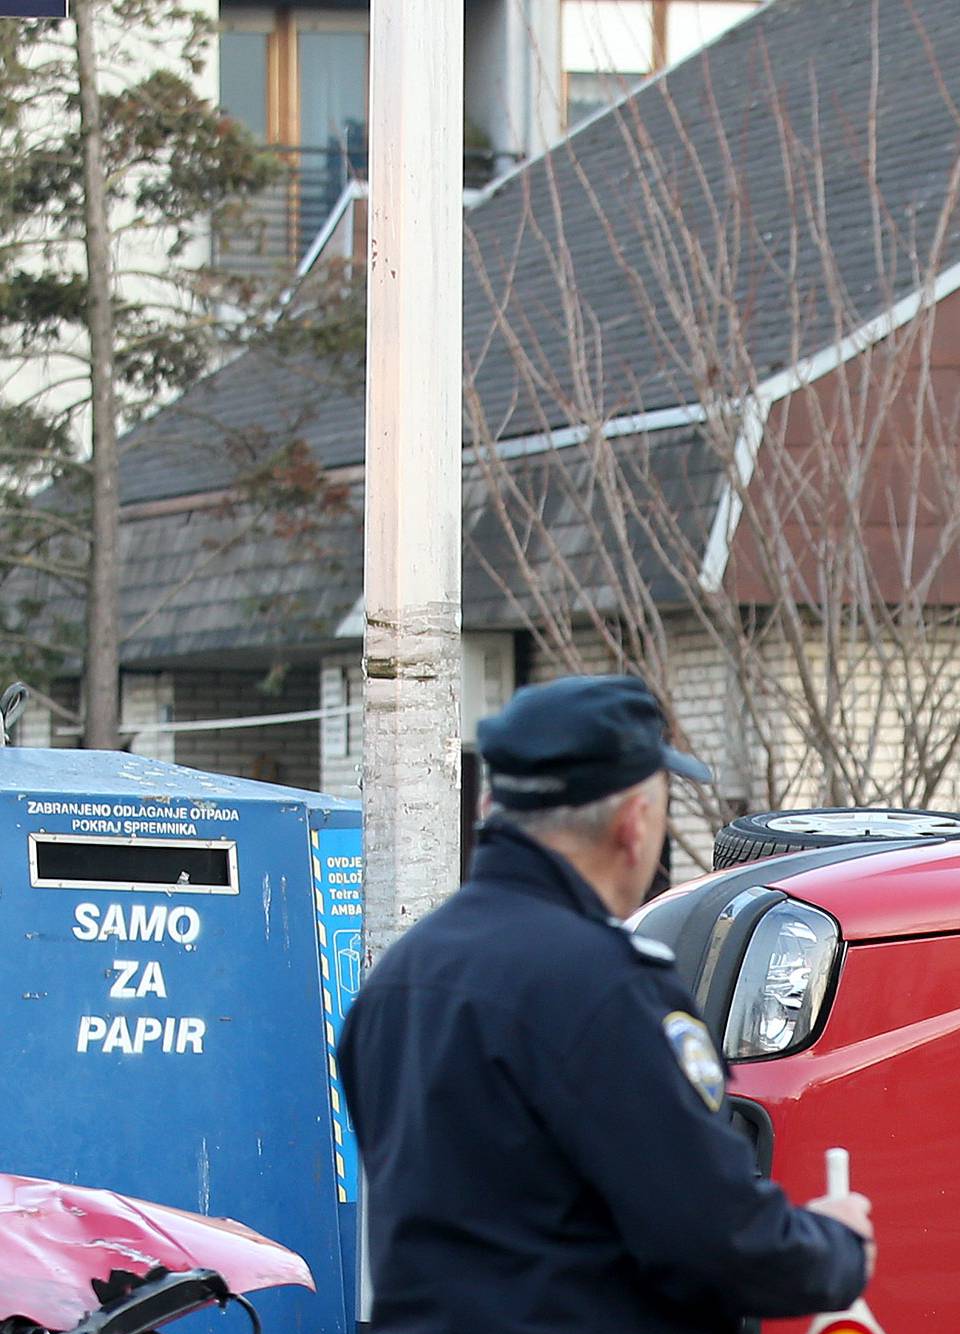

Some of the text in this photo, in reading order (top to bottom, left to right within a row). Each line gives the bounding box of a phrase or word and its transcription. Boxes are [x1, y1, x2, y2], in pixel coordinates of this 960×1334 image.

[27, 801, 239, 821] ZABRANJENO ODLAGANJE OTPADA
[72, 819, 197, 836] POKRAJ SPREMNIKA
[327, 856, 362, 868] OVDJE
[329, 888, 359, 900] Tetra
[72, 902, 200, 944] SAMO
[109, 960, 168, 999] ZA
[76, 1015, 206, 1054] PAPIR
